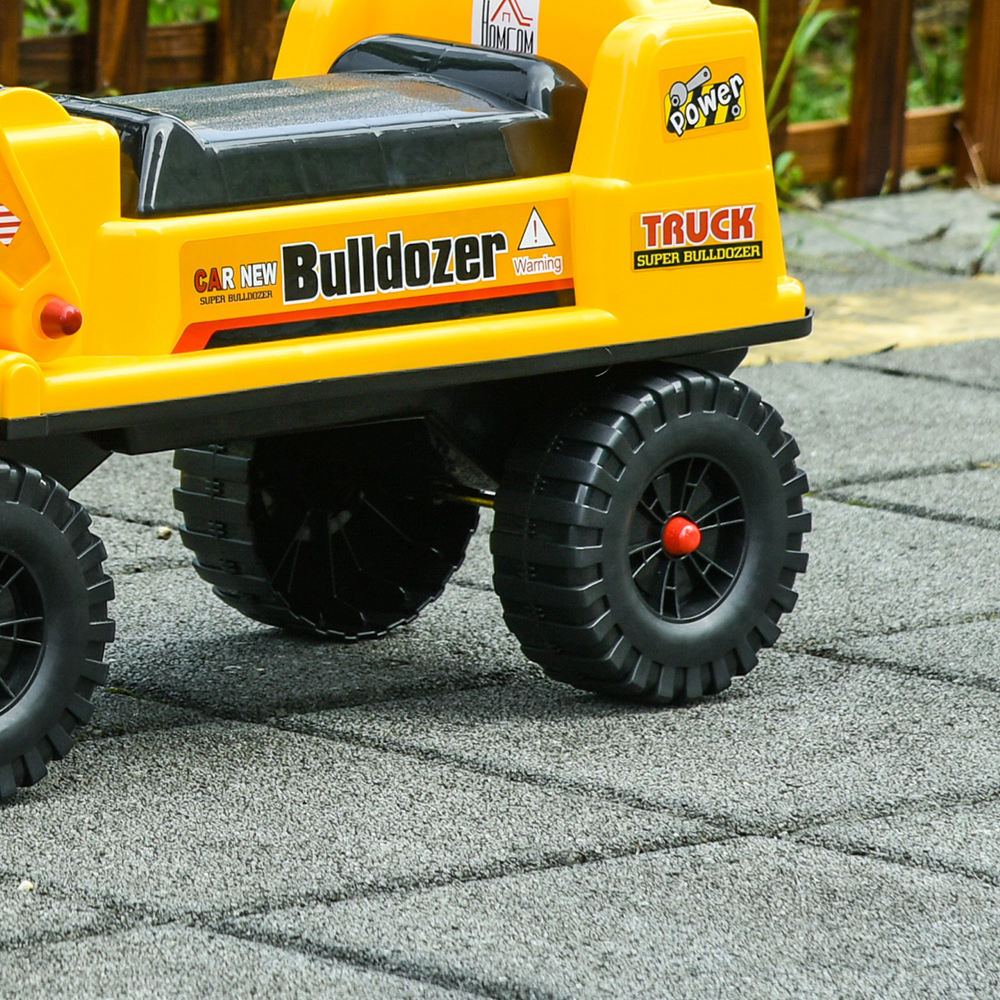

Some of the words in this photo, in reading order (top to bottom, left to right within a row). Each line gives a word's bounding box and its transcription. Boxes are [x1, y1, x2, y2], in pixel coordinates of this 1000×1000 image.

[641, 205, 756, 248] TRUCK
[193, 265, 236, 294] CAR
[239, 260, 278, 289] NEW
[281, 230, 508, 304] Bulldozer
[513, 254, 563, 275] Warning
[636, 250, 680, 268] SUPER
[683, 244, 762, 264] BULLDOZER
[199, 294, 226, 306] SUPER
[227, 289, 273, 303] BULLDOZER
